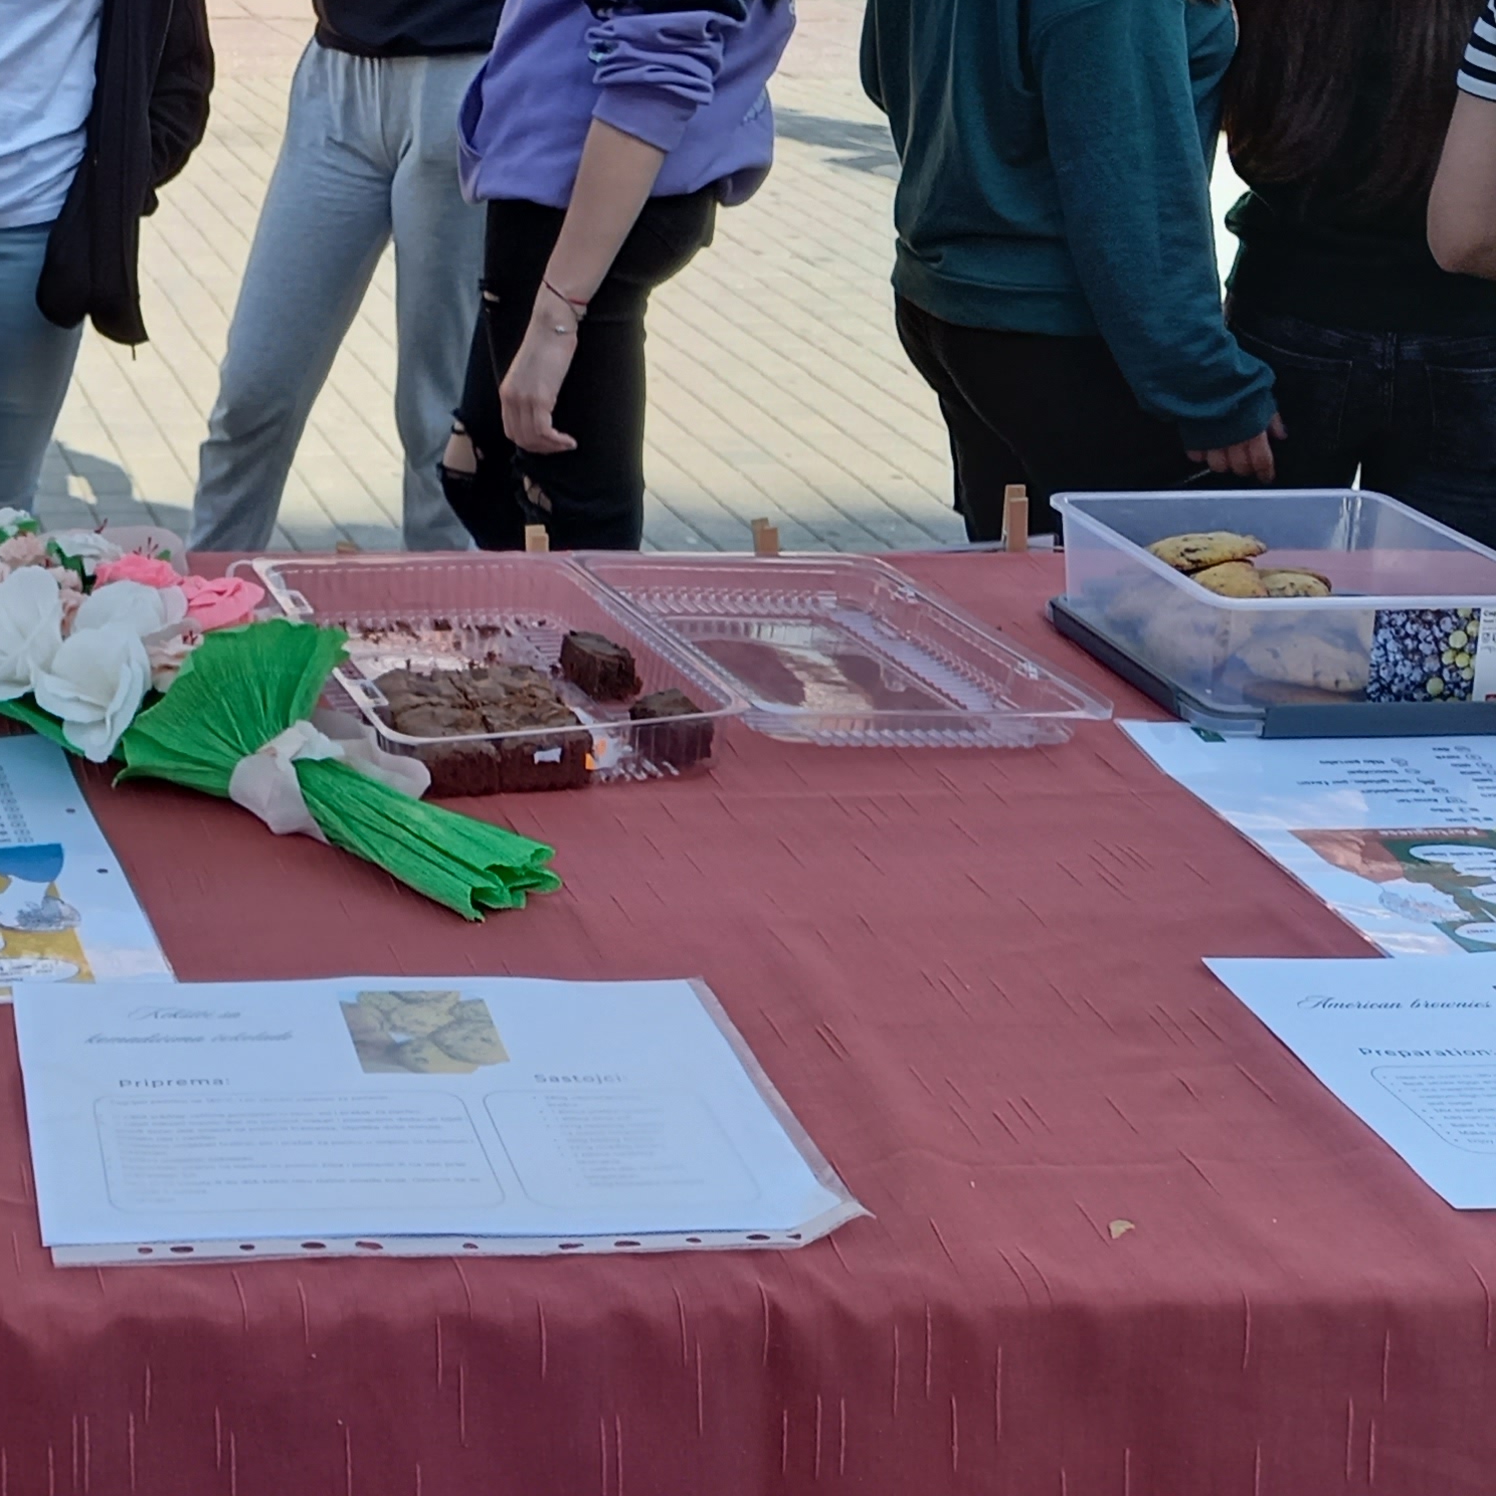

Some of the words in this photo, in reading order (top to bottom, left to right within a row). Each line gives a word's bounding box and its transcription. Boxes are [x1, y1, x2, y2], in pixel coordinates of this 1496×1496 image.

[1296, 994, 1403, 1010] American
[1409, 998, 1492, 1009] brownies
[118, 1076, 231, 1089] Priprema:
